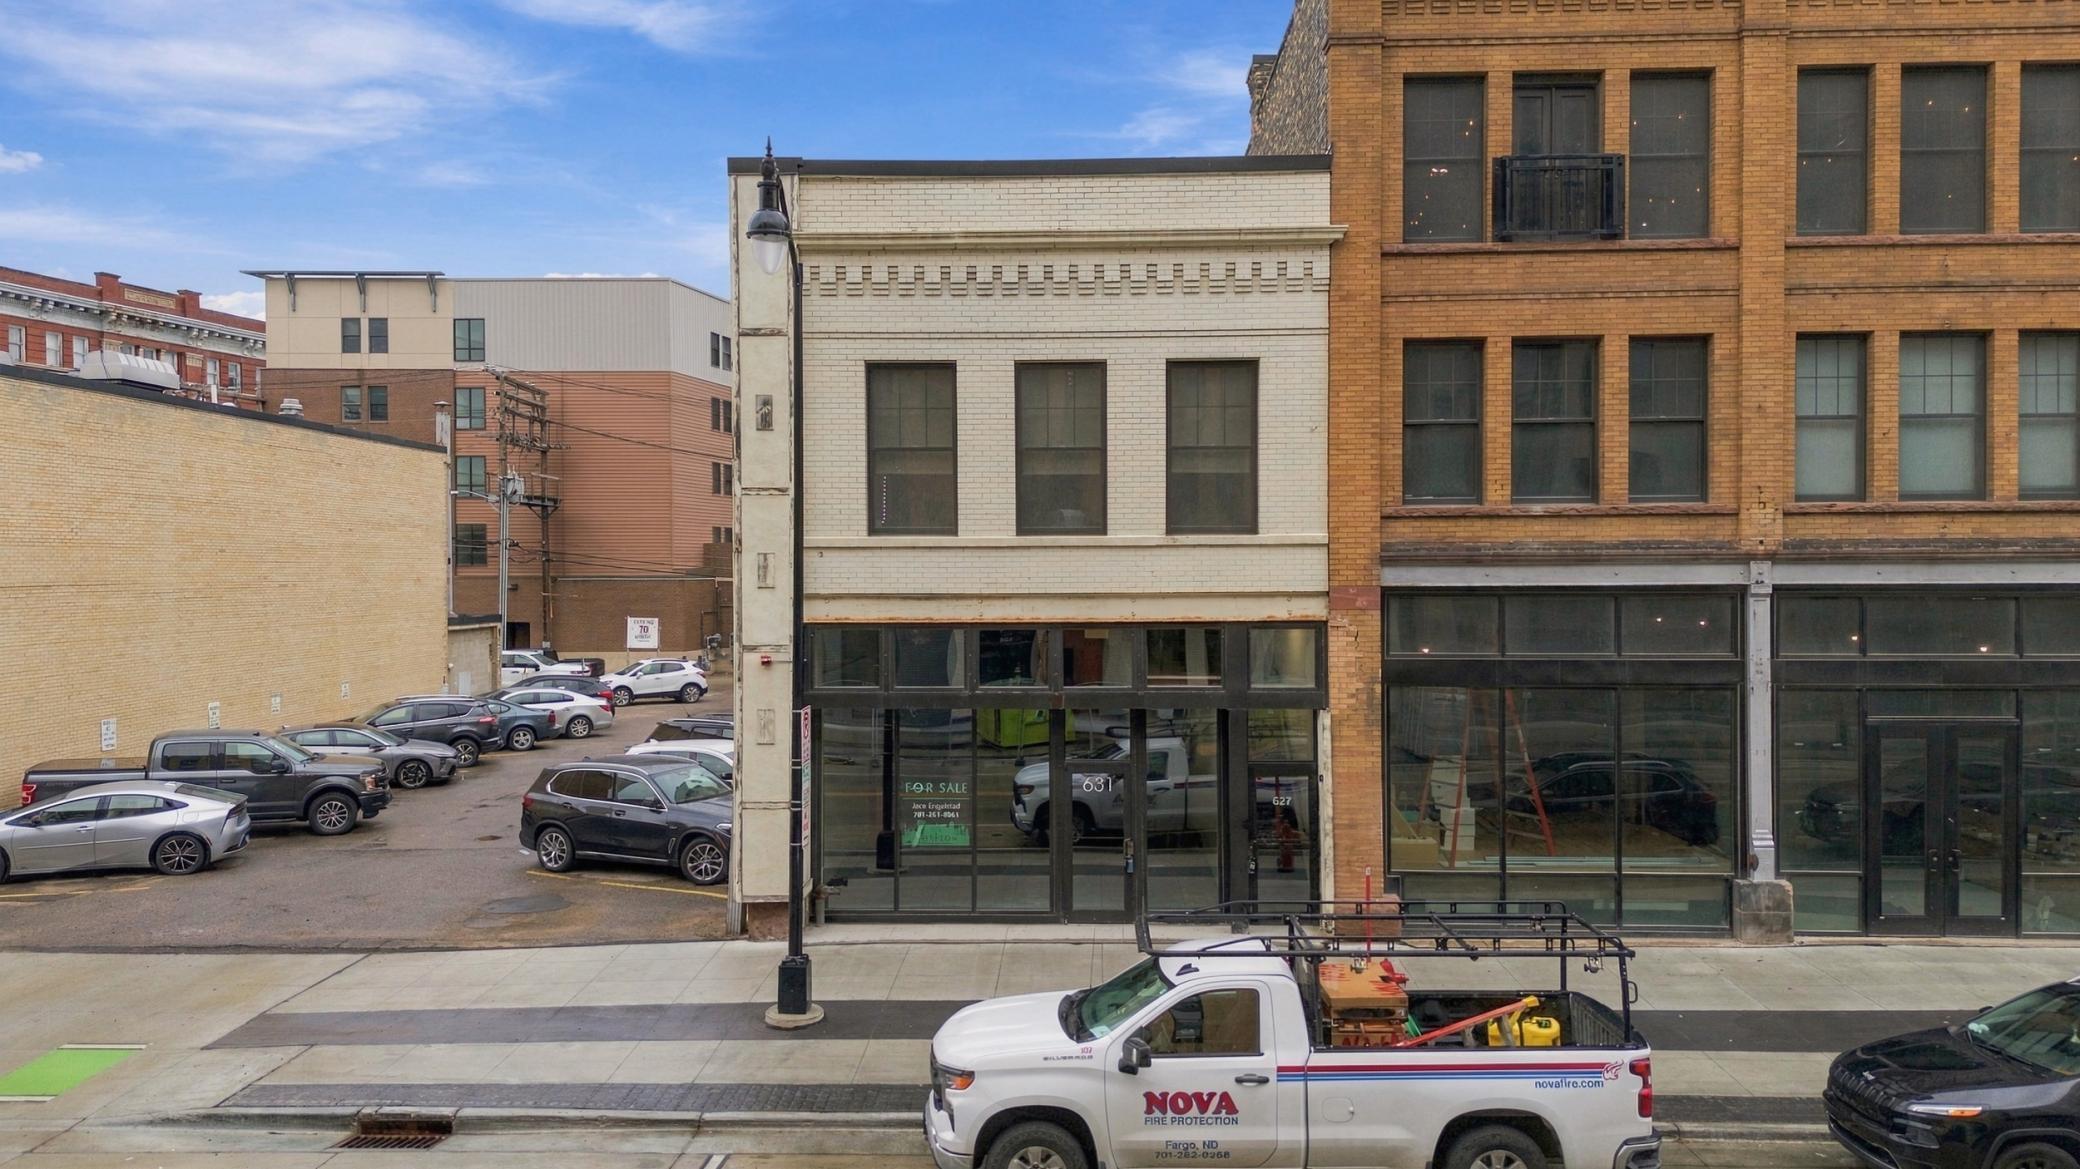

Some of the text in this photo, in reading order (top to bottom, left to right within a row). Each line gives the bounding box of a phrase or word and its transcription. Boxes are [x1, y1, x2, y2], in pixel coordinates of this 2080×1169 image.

[905, 782, 968, 793] FOR SALE
[1083, 776, 1112, 792] 631
[1272, 796, 1292, 806] 627
[1535, 1078, 1604, 1089] novafire.com
[1143, 1091, 1239, 1116] NOVA
[1144, 1116, 1239, 1126] FIRE PROTECTION
[1165, 1140, 1219, 1152] Fargo, ND
